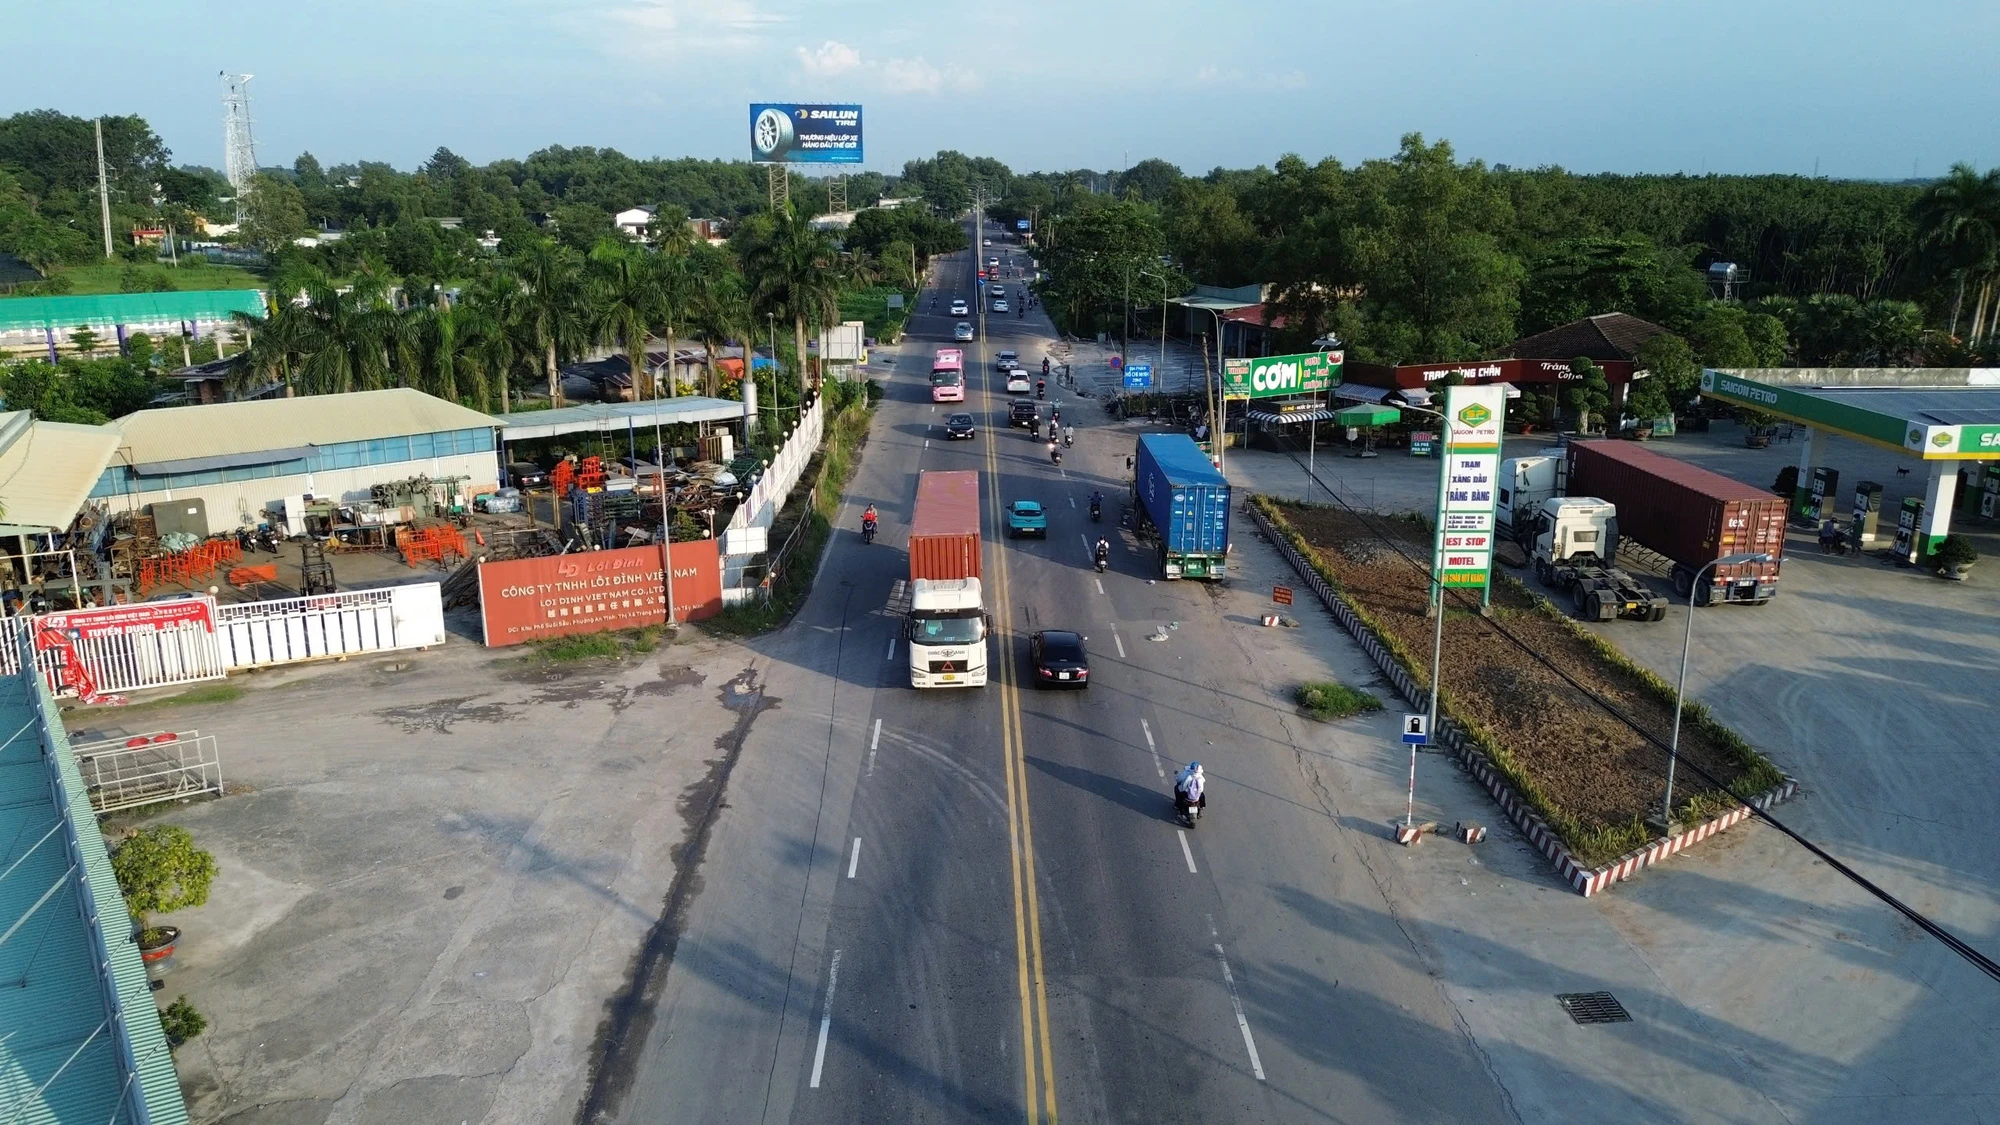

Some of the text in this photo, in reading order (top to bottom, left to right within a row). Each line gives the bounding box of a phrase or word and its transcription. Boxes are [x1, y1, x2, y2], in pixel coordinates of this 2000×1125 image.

[810, 110, 858, 119] SAILUN
[1478, 364, 1501, 377] CHÂN
[1253, 362, 1297, 392] CƠM
[1720, 380, 1778, 404] SAIGON PETRO
[1471, 489, 1490, 501] BÀNG
[1728, 518, 1745, 527] tex
[1465, 538, 1486, 546] STOP
[1448, 557, 1475, 565] MOTEL
[502, 568, 697, 598] CÔNG TY TNHH LÔI ĐÌNH VIỆ NAM
[560, 597, 583, 605] DINH
[585, 592, 607, 601] VIET
[609, 590, 629, 599] NAM
